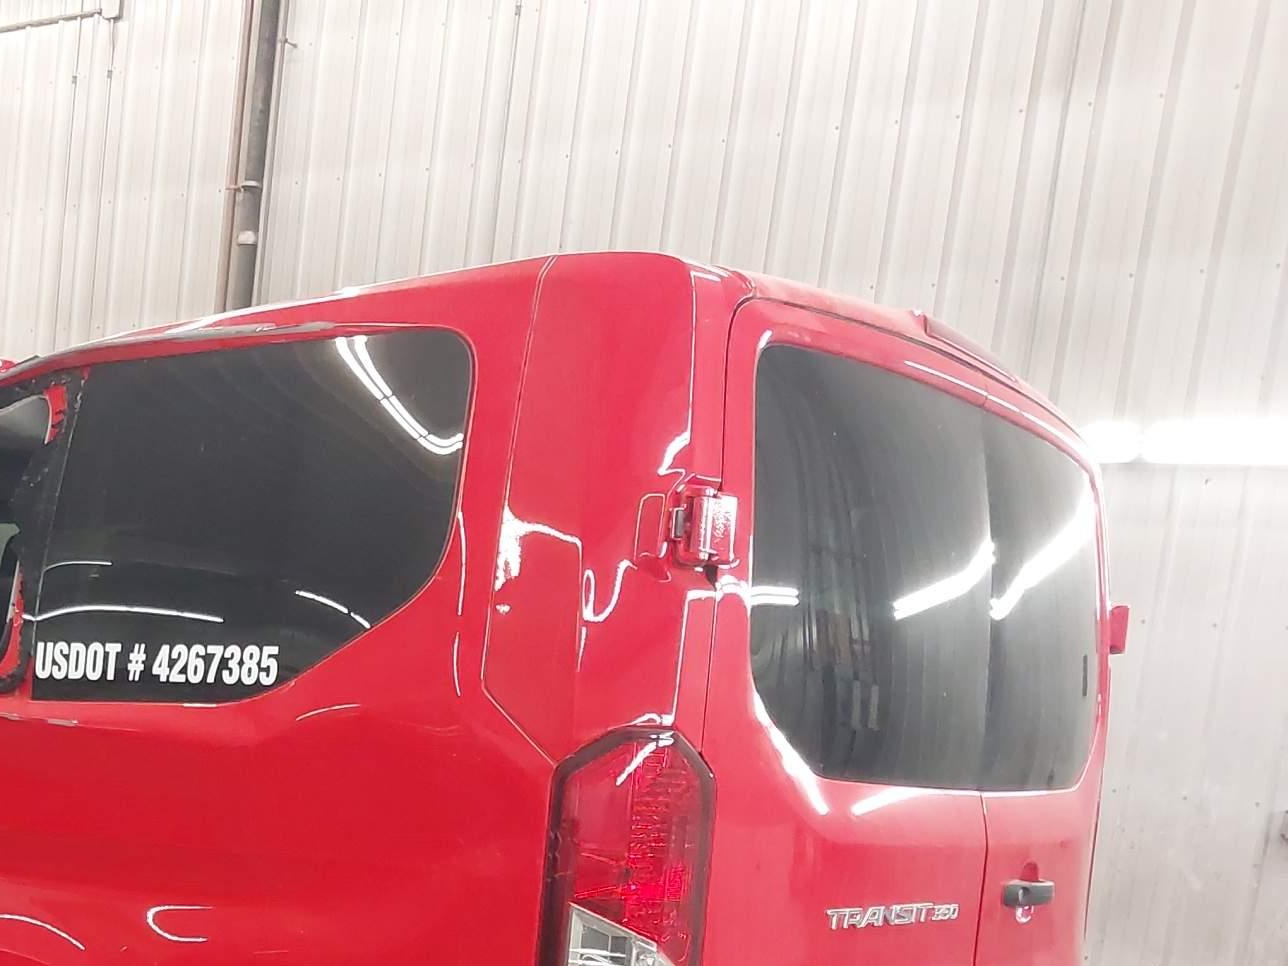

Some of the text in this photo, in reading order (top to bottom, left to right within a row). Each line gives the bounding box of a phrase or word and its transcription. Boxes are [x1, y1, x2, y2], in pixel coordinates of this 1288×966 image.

[35, 641, 279, 686] USDOT # 4267385
[826, 902, 934, 930] TRANSIT
